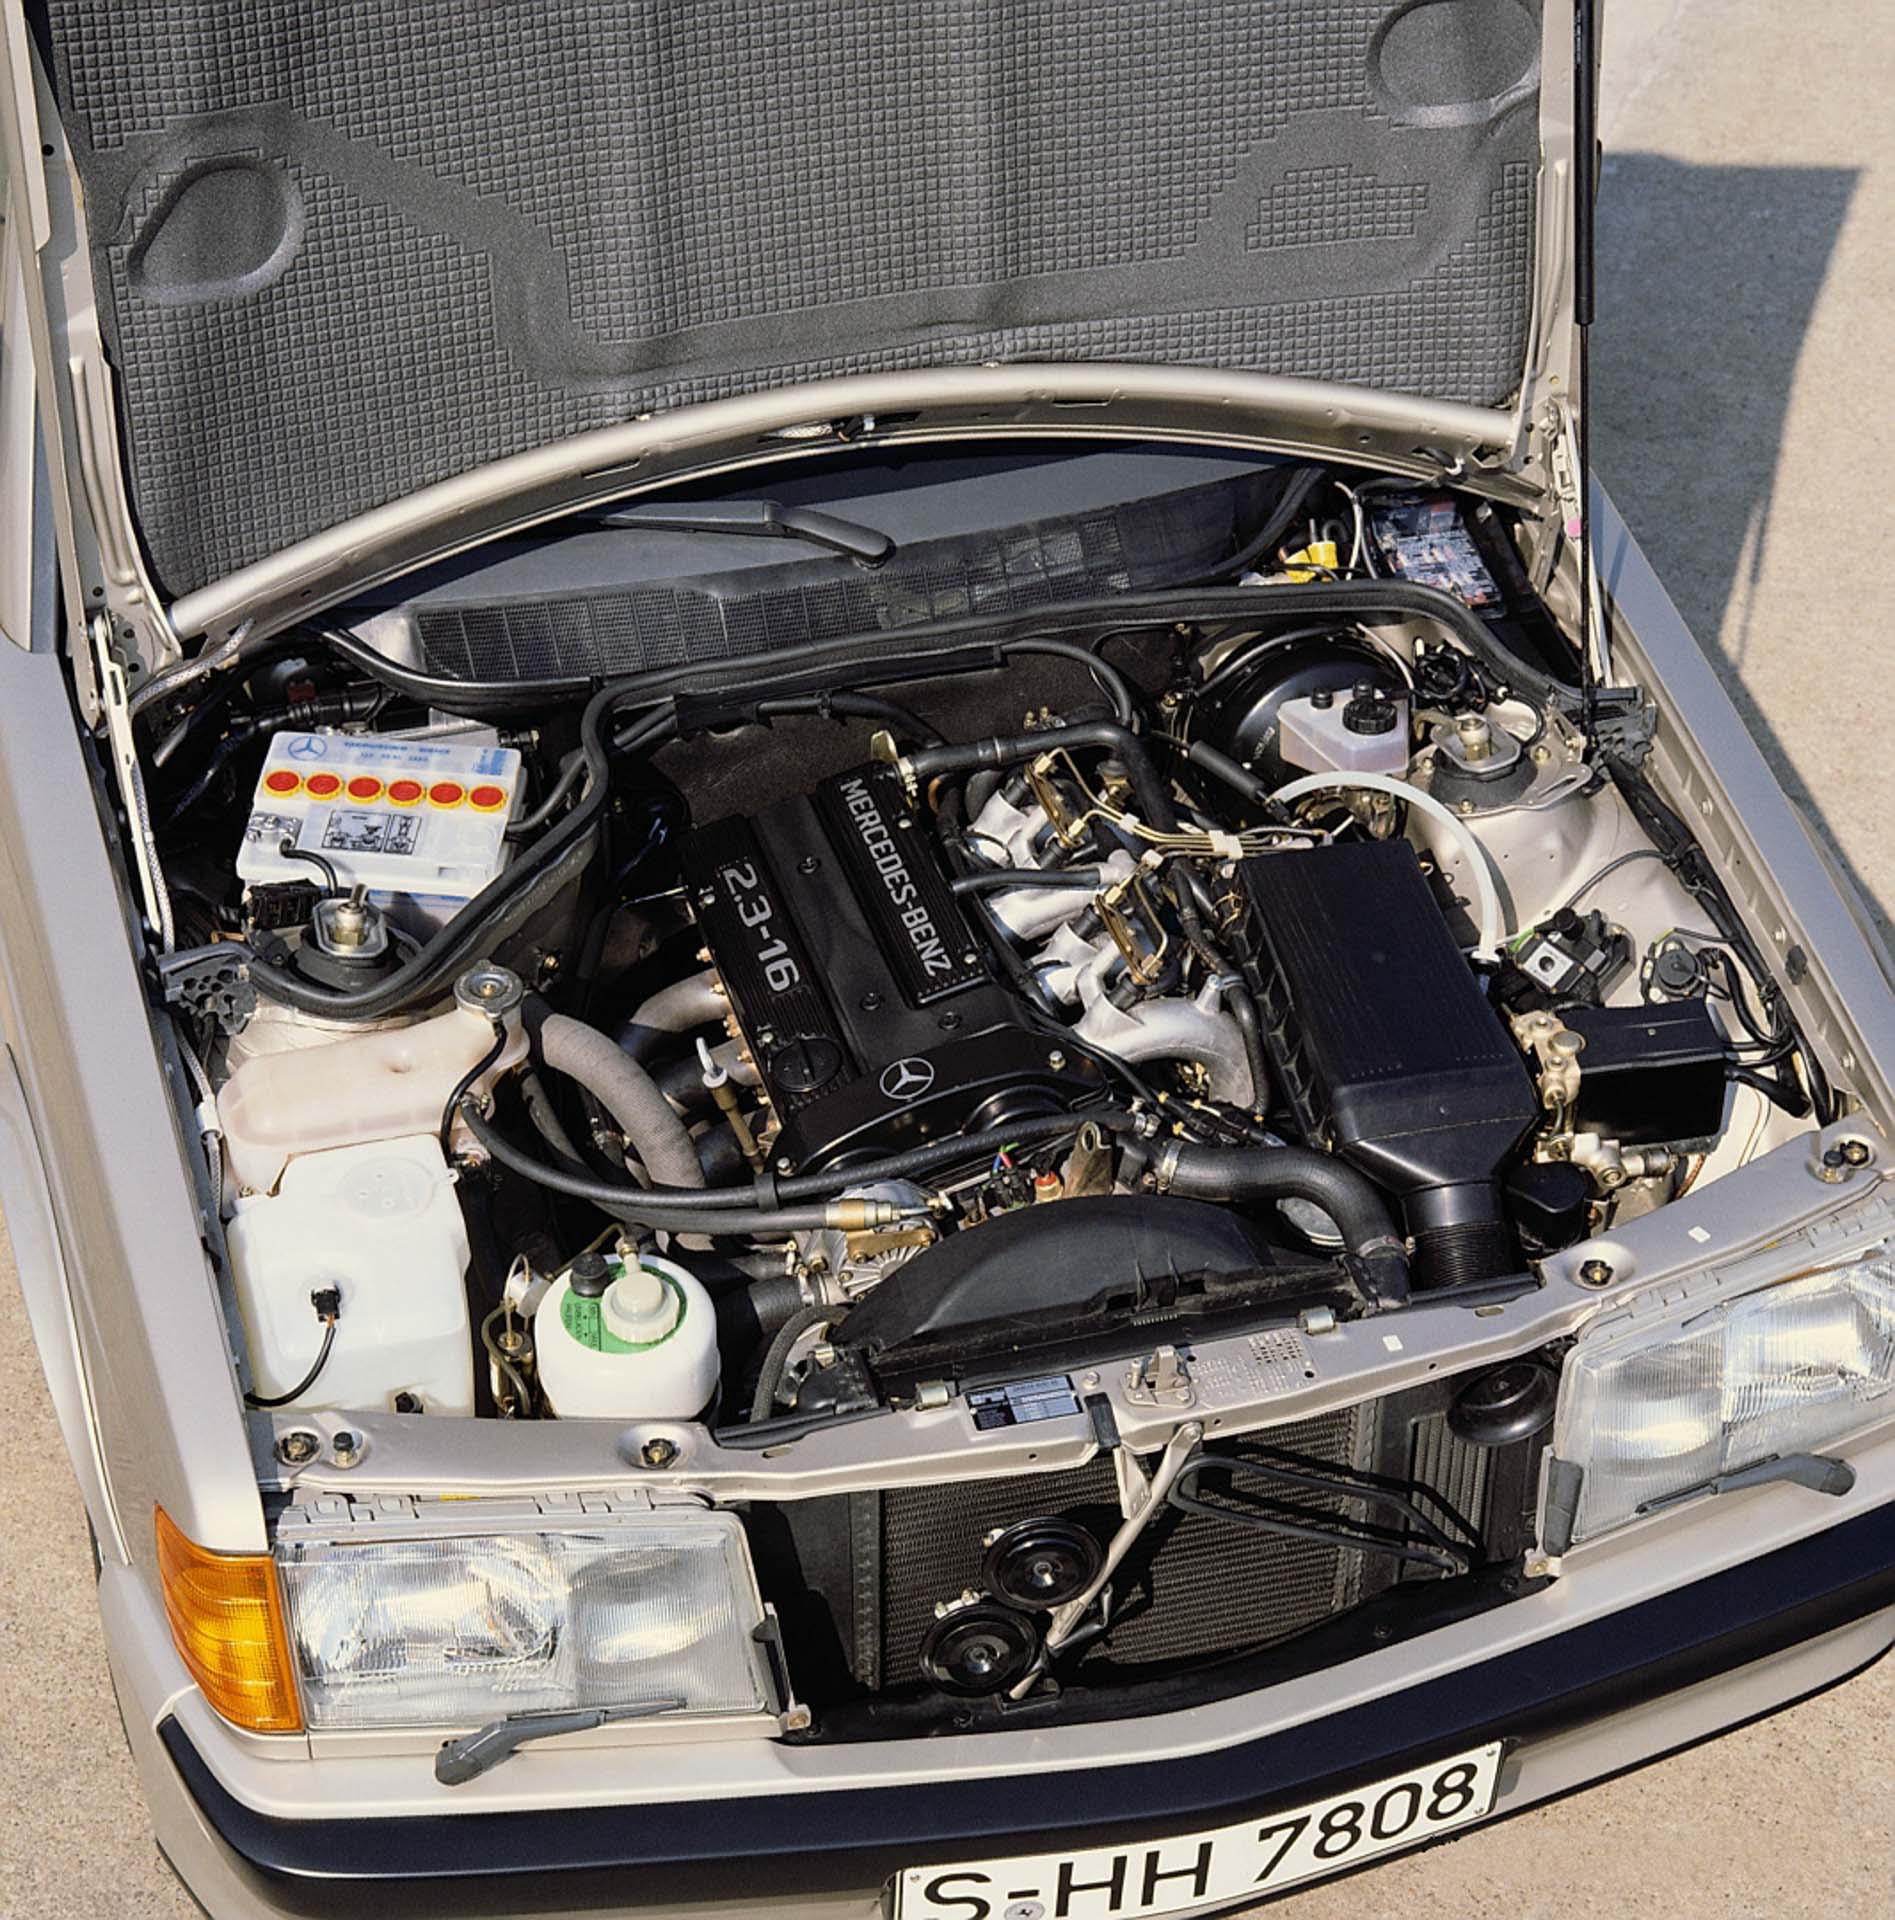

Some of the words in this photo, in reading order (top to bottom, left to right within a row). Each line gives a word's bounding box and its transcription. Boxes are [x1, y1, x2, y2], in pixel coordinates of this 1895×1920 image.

[724, 863, 800, 991] 2.3-16
[840, 778, 952, 976] MERCEDES-BENZ
[924, 1841, 1214, 1920] S-HH
[1254, 1762, 1479, 1882] 7808
